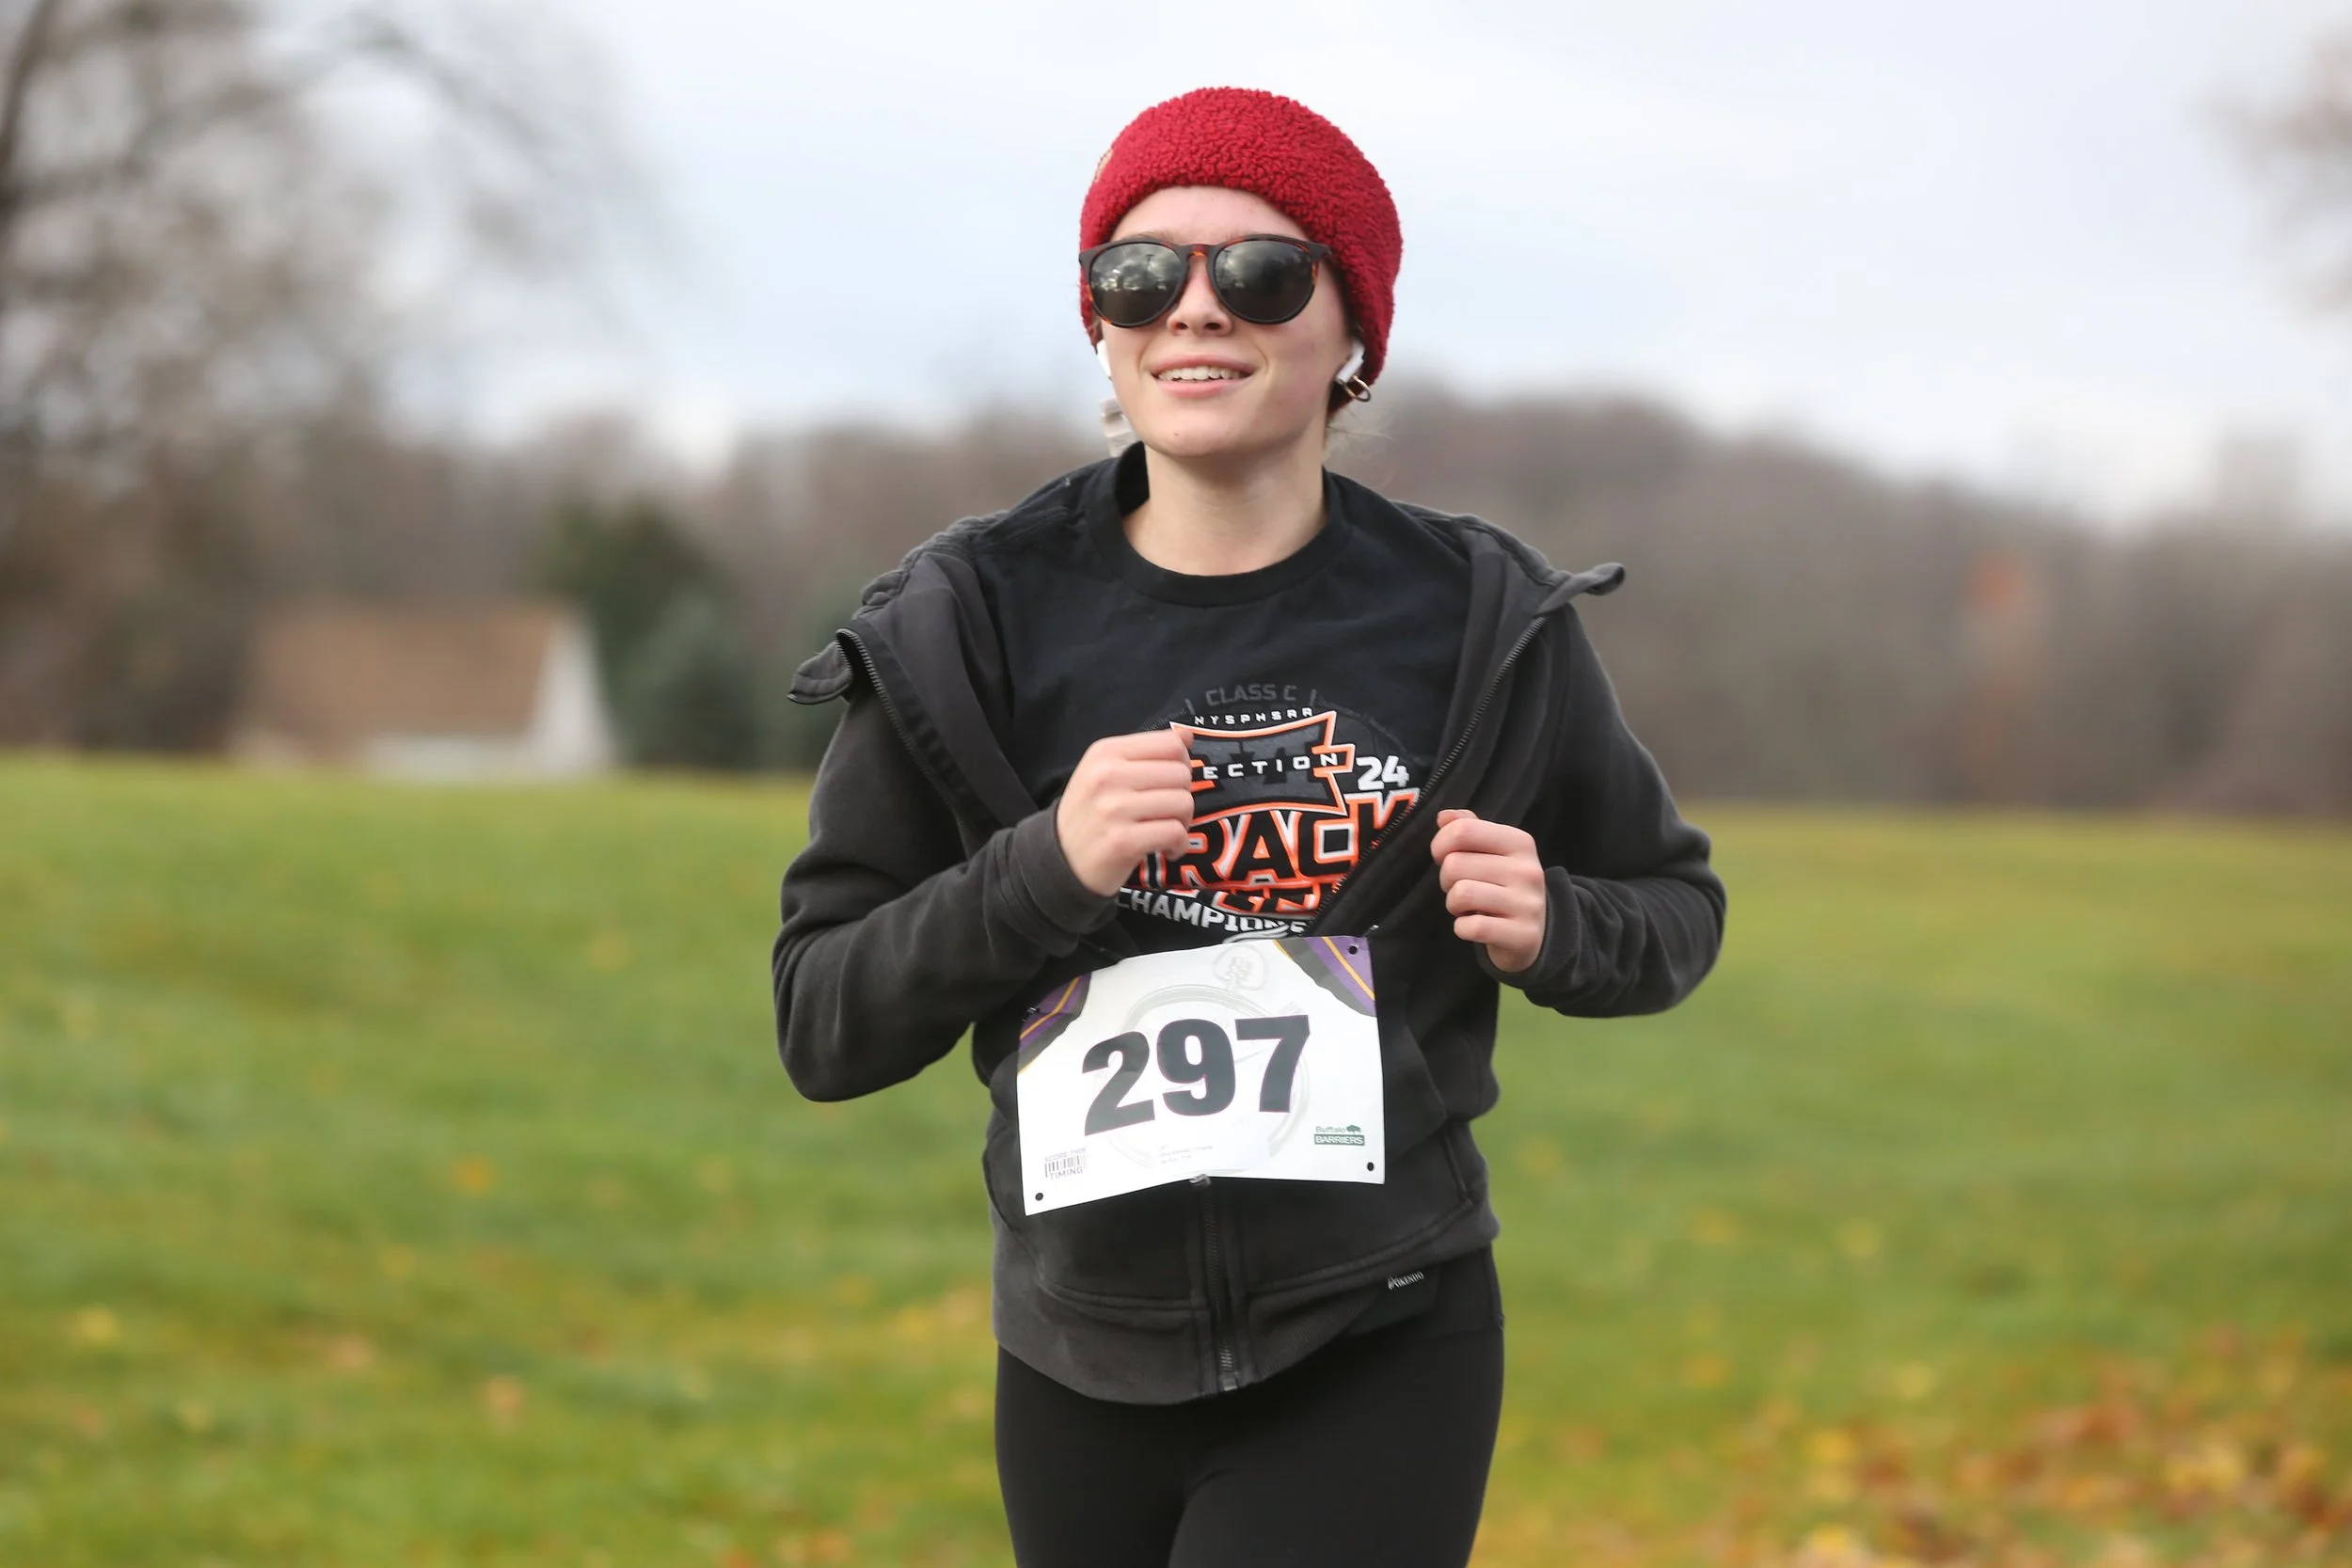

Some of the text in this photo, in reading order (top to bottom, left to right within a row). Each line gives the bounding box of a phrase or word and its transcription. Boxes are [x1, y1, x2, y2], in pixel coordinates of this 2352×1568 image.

[1205, 683, 1298, 706] CLASS C
[1203, 752, 1338, 781] ECTION
[1356, 755, 1410, 790] 24
[1082, 1014, 1311, 1136] 297
[1315, 1135, 1364, 1145] BARRIERS
[1049, 1166, 1084, 1180] TIMING
